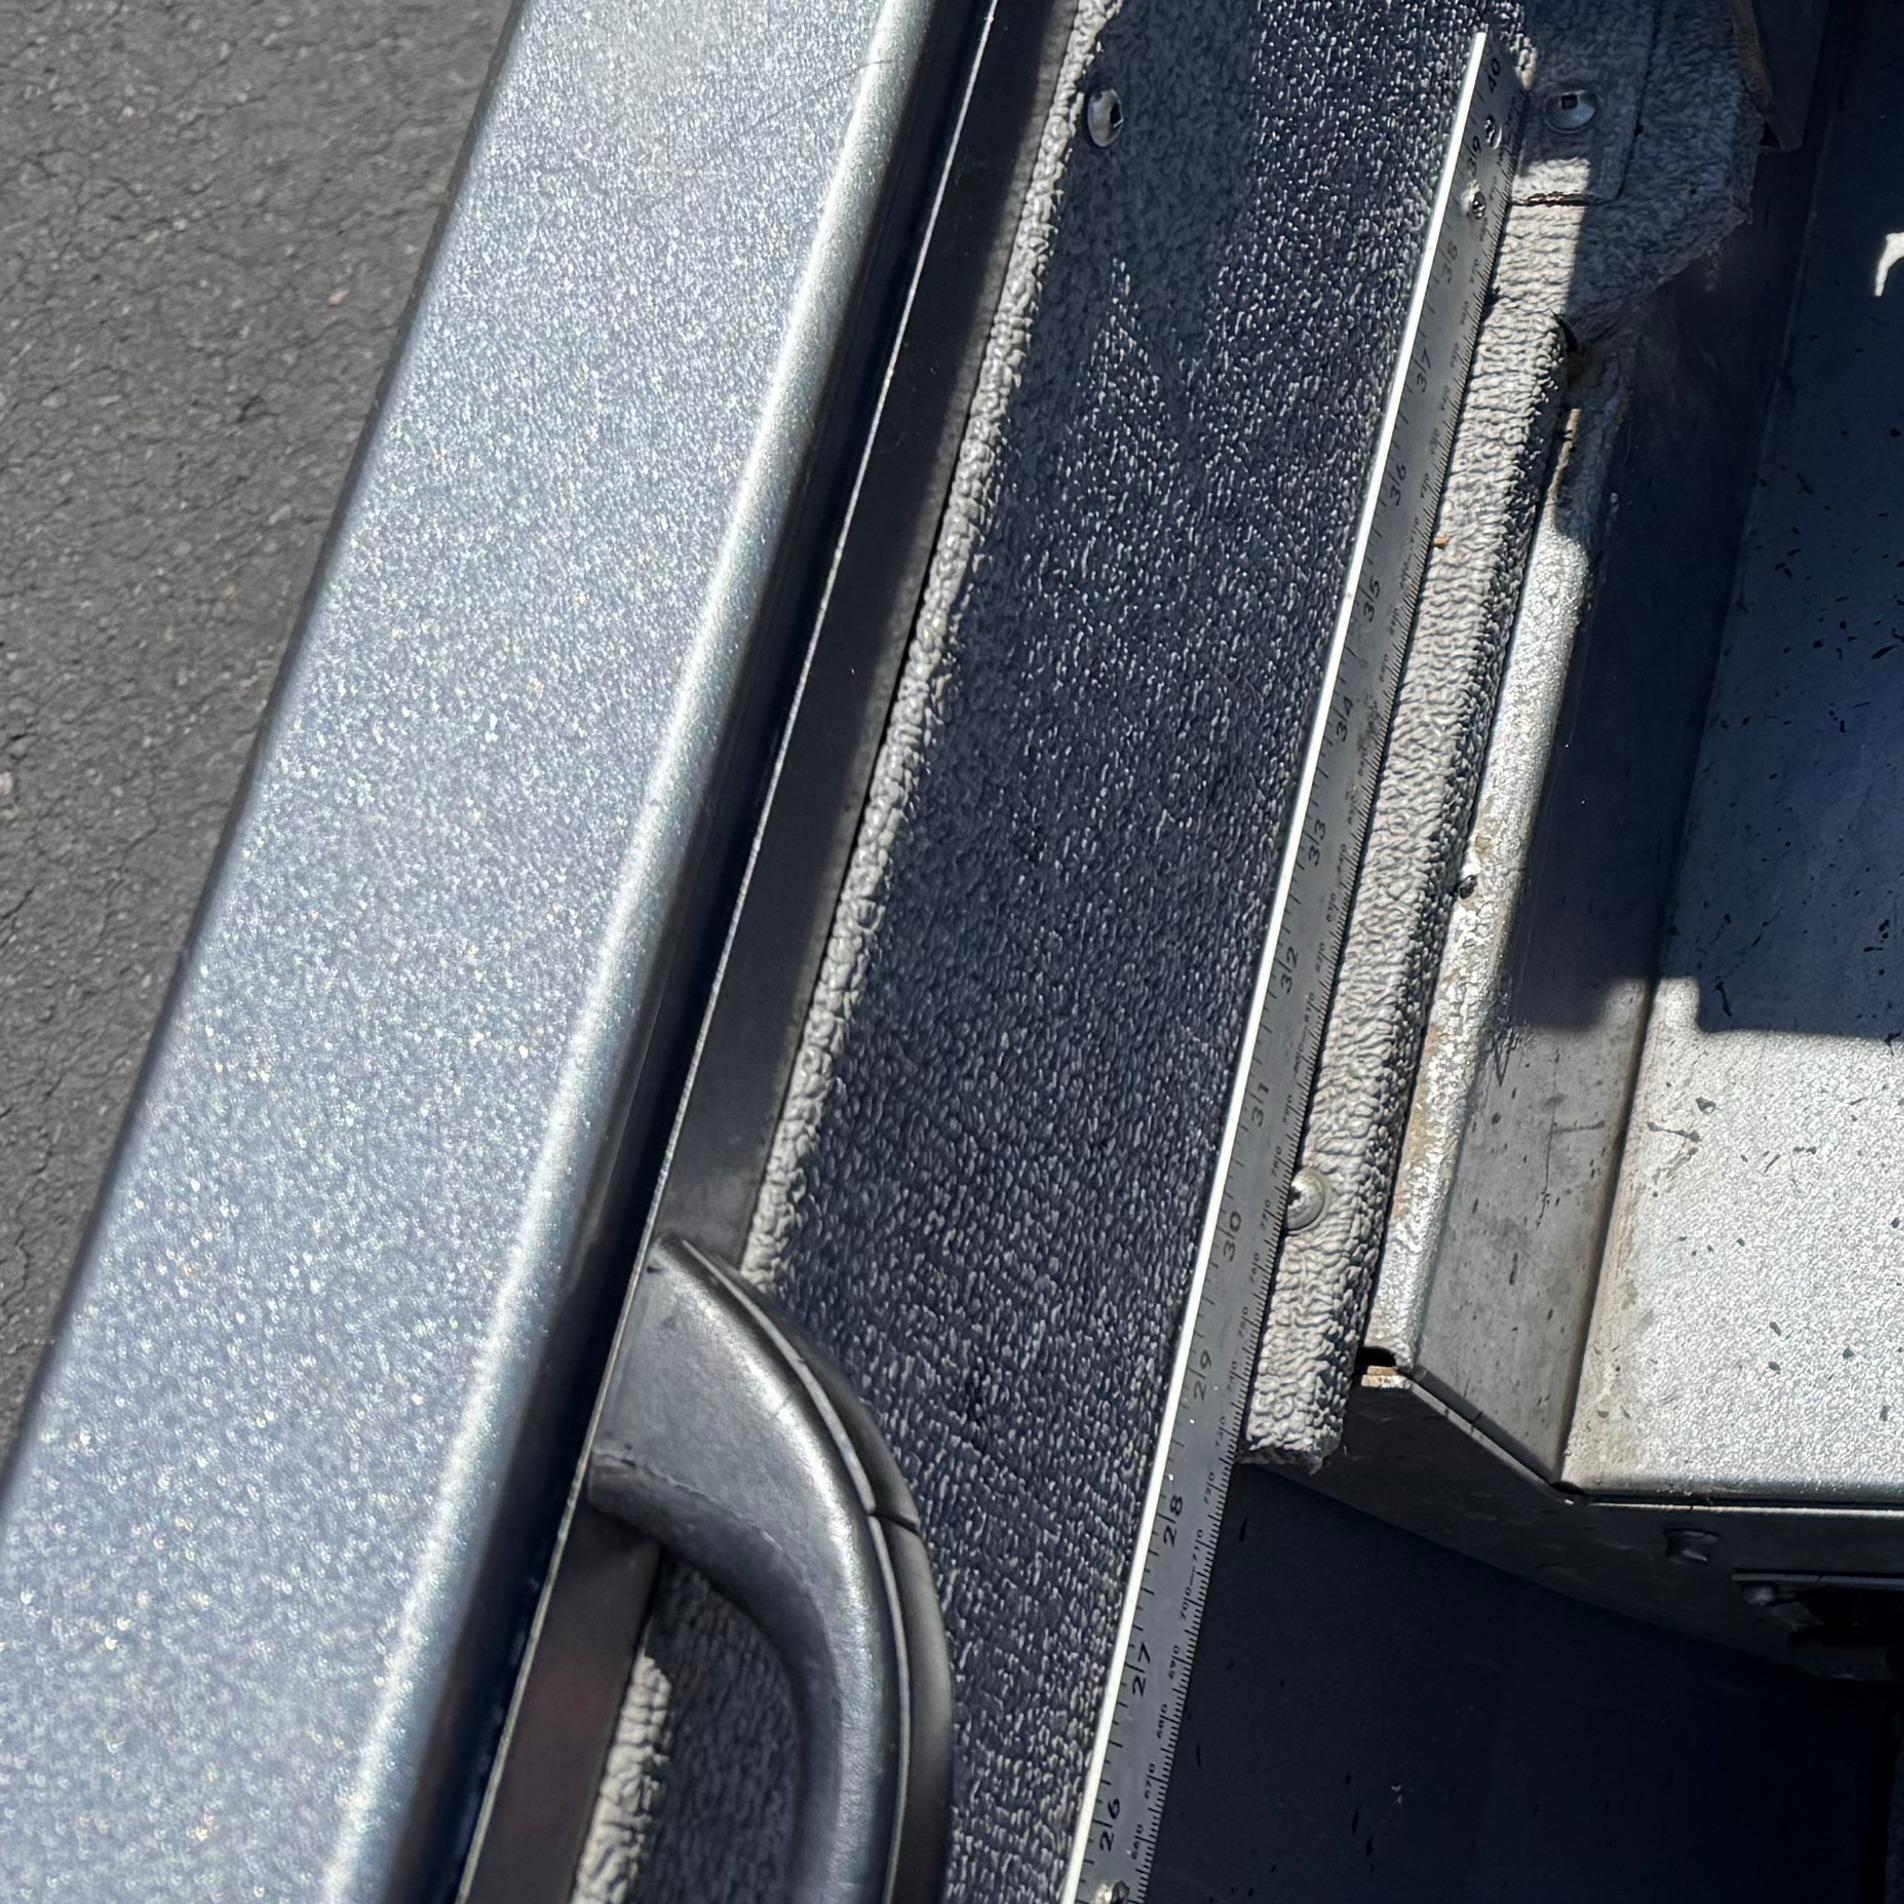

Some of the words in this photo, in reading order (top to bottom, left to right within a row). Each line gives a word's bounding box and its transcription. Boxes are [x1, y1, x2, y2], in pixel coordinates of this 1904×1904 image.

[1416, 349, 1433, 393] 37
[1391, 464, 1407, 506] 36
[1363, 581, 1380, 623] 35
[1336, 698, 1355, 742] 34
[1308, 819, 1327, 867] 33
[1280, 946, 1300, 995] 32
[1250, 1082, 1270, 1127] 31
[1223, 1211, 1243, 1261] 30
[1193, 1350, 1213, 1401] 29
[1163, 1496, 1184, 1548] 28
[1132, 1642, 1152, 1697] 27
[1100, 1797, 1122, 1852] 26
